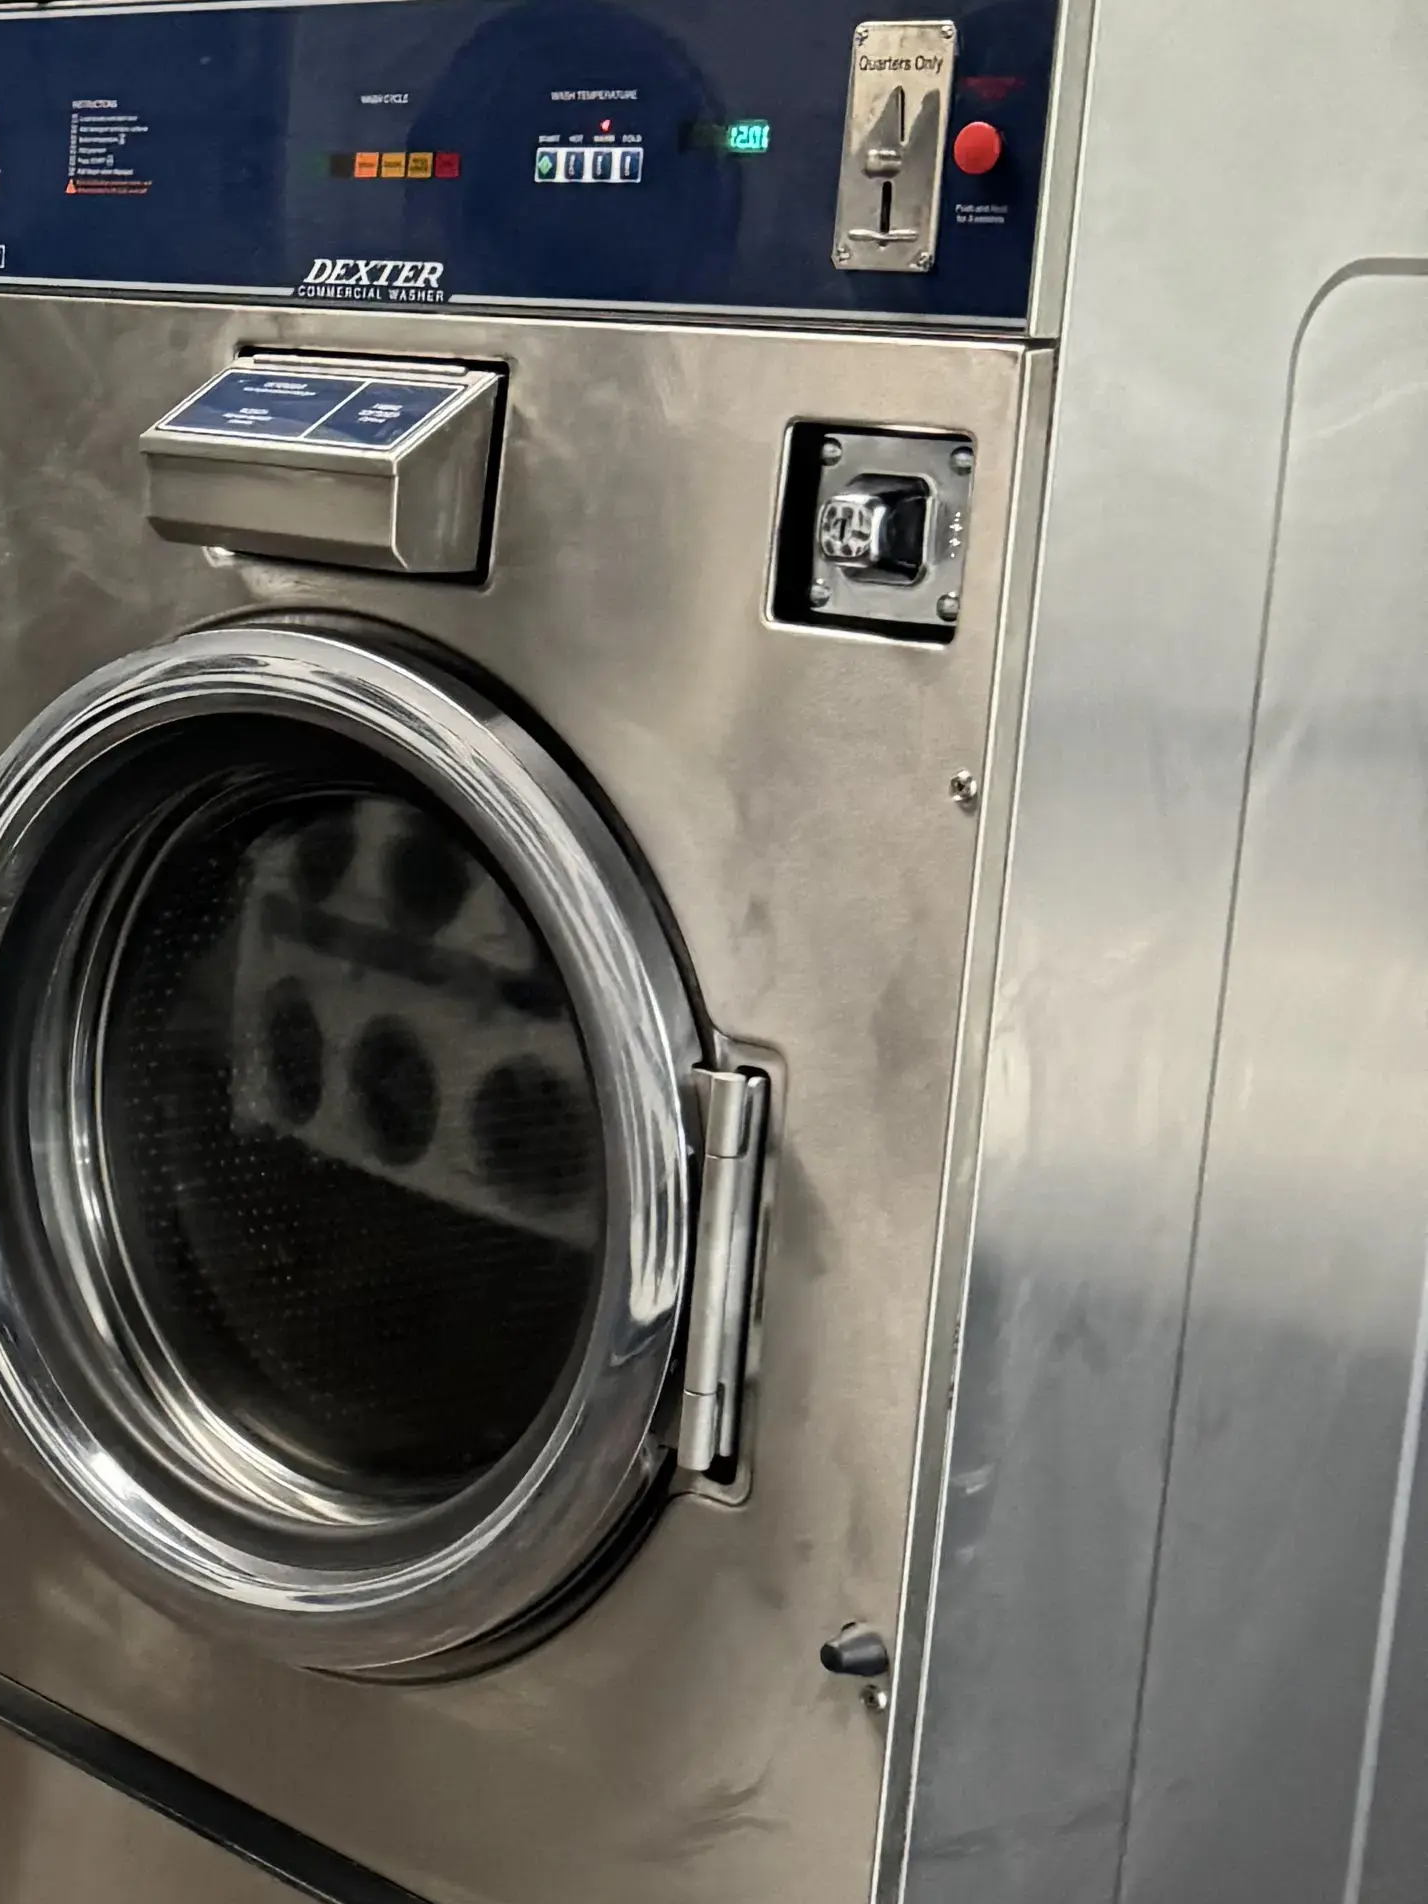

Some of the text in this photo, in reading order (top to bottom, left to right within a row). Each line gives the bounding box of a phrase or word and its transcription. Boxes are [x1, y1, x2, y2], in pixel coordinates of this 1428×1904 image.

[859, 54, 943, 74] Quarters Only
[303, 259, 444, 288] DEXTER
[298, 285, 445, 303] COMMERCIAL WASHER
